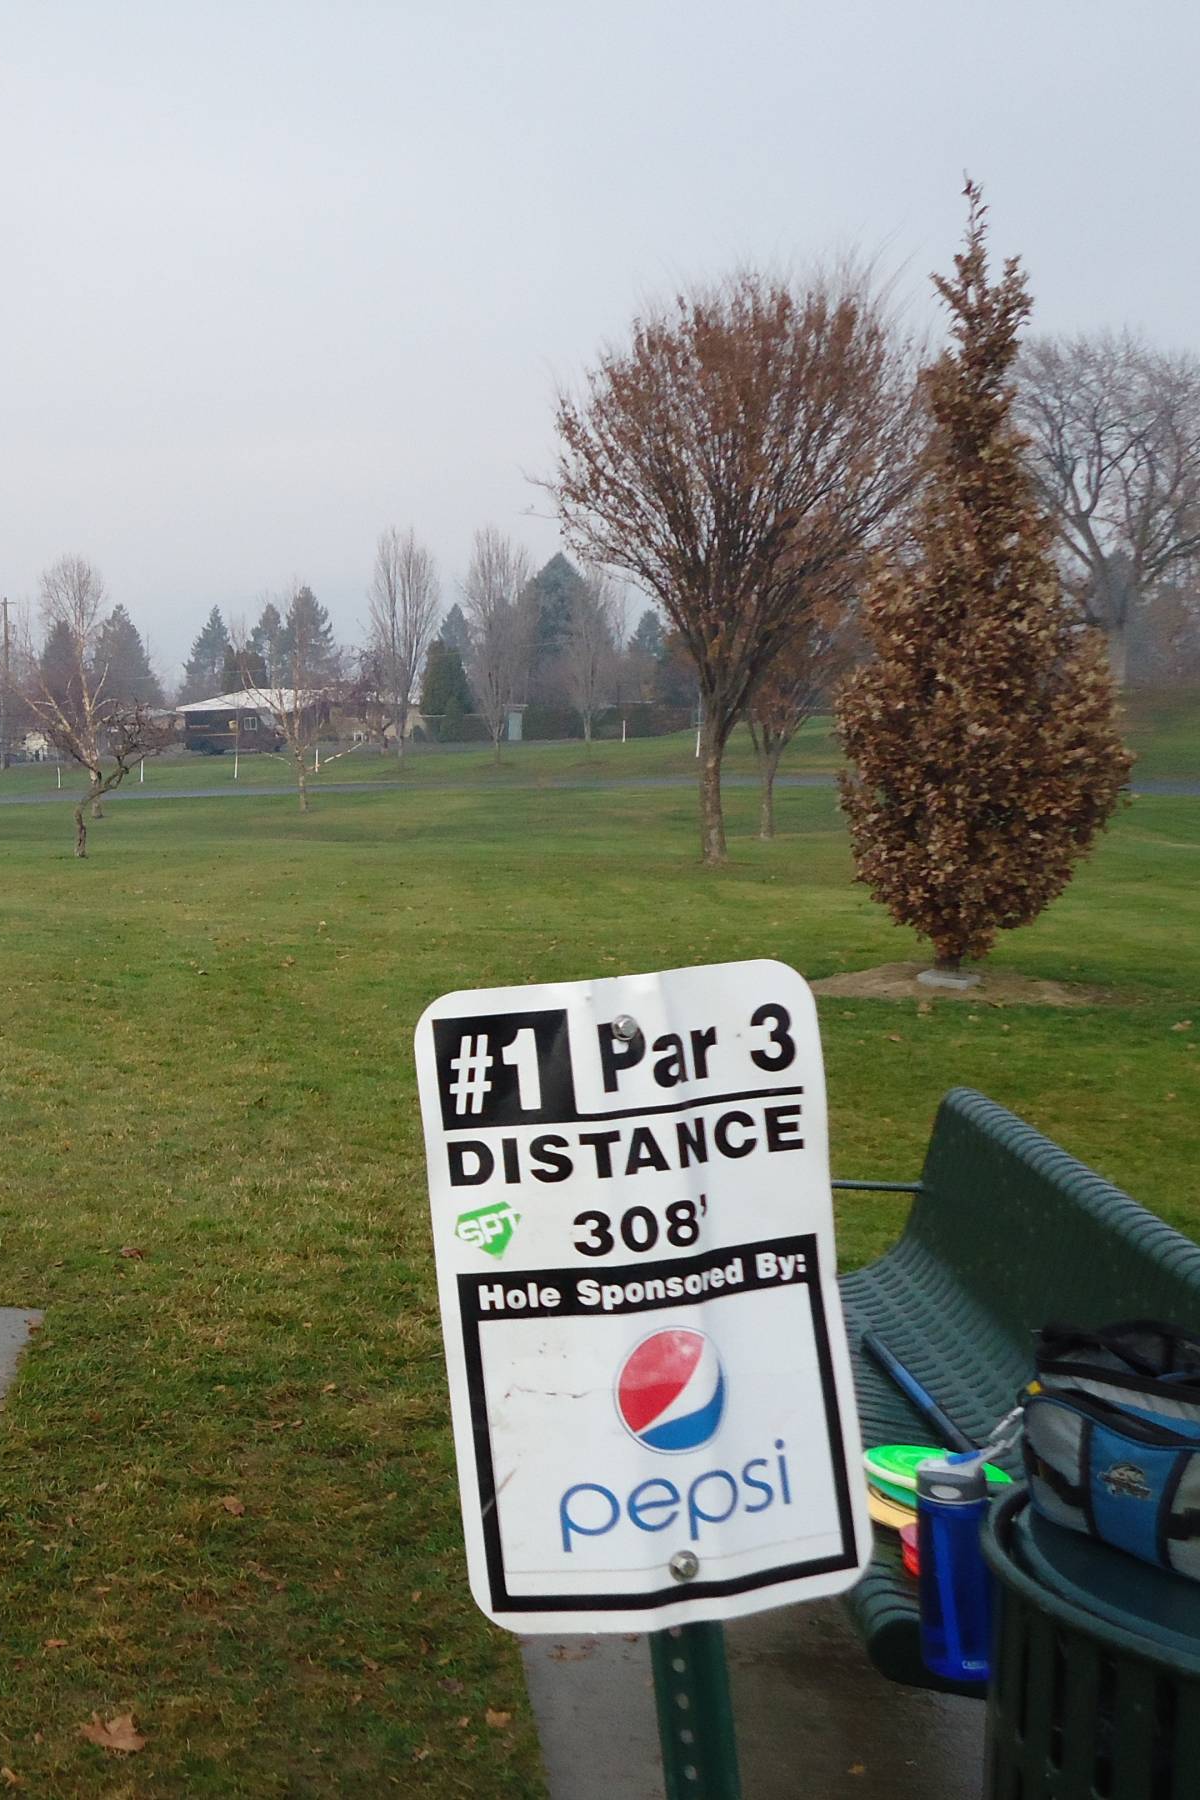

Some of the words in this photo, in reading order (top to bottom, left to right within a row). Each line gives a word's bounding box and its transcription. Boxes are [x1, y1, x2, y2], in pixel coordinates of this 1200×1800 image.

[449, 1027, 543, 1116] #1
[597, 1019, 717, 1093] Par
[750, 1003, 796, 1072] 3
[447, 1104, 805, 1187] DISTANCE
[478, 1282, 561, 1311] Hole
[576, 1257, 744, 1310] Sponsored
[755, 1252, 806, 1280] By:
[559, 1438, 792, 1553] pepsi
